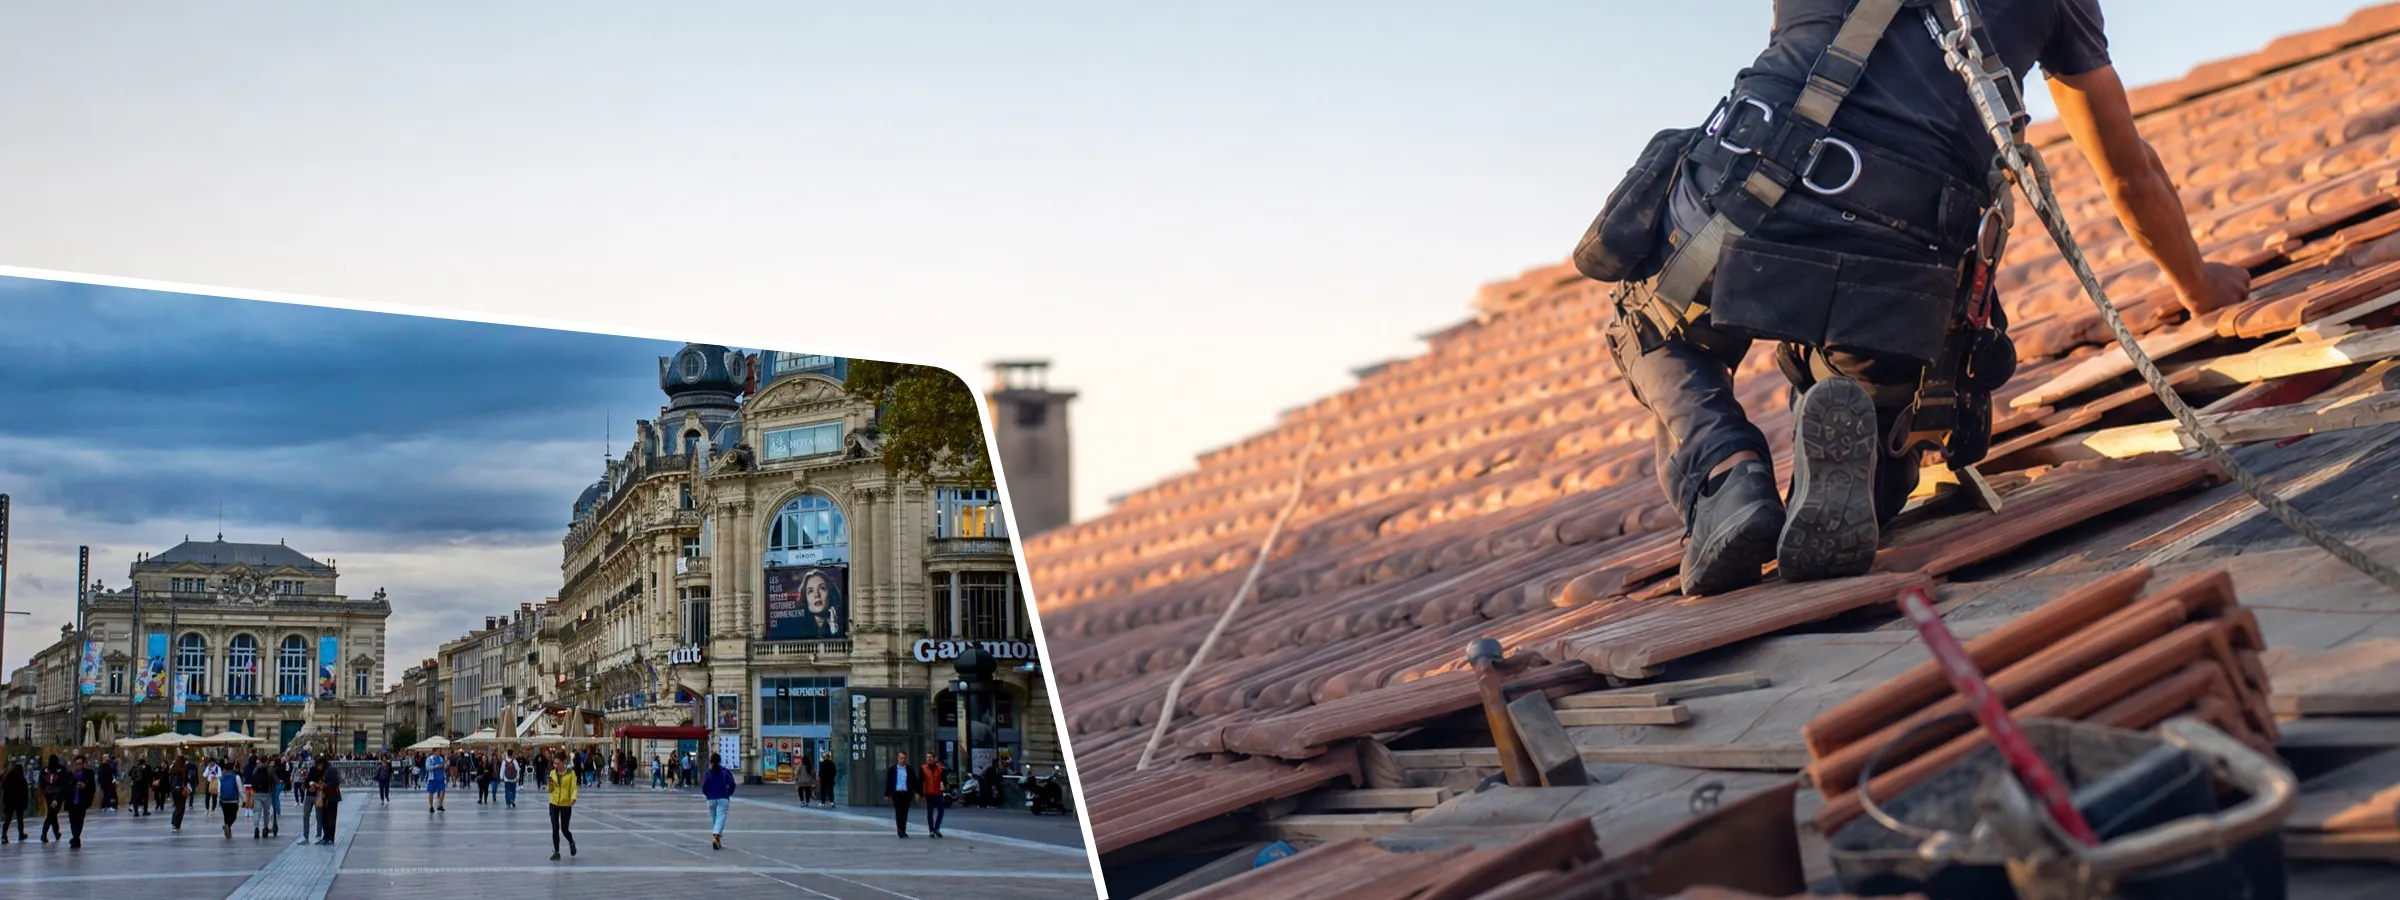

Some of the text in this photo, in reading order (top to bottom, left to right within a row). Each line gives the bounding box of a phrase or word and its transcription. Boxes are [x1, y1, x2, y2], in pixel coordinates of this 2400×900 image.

[769, 576, 779, 584] LES
[769, 584, 783, 593] PLUS
[769, 593, 788, 601] BELLES
[769, 601, 796, 610] HISTOIRES
[769, 609, 805, 619] COMMENCENT
